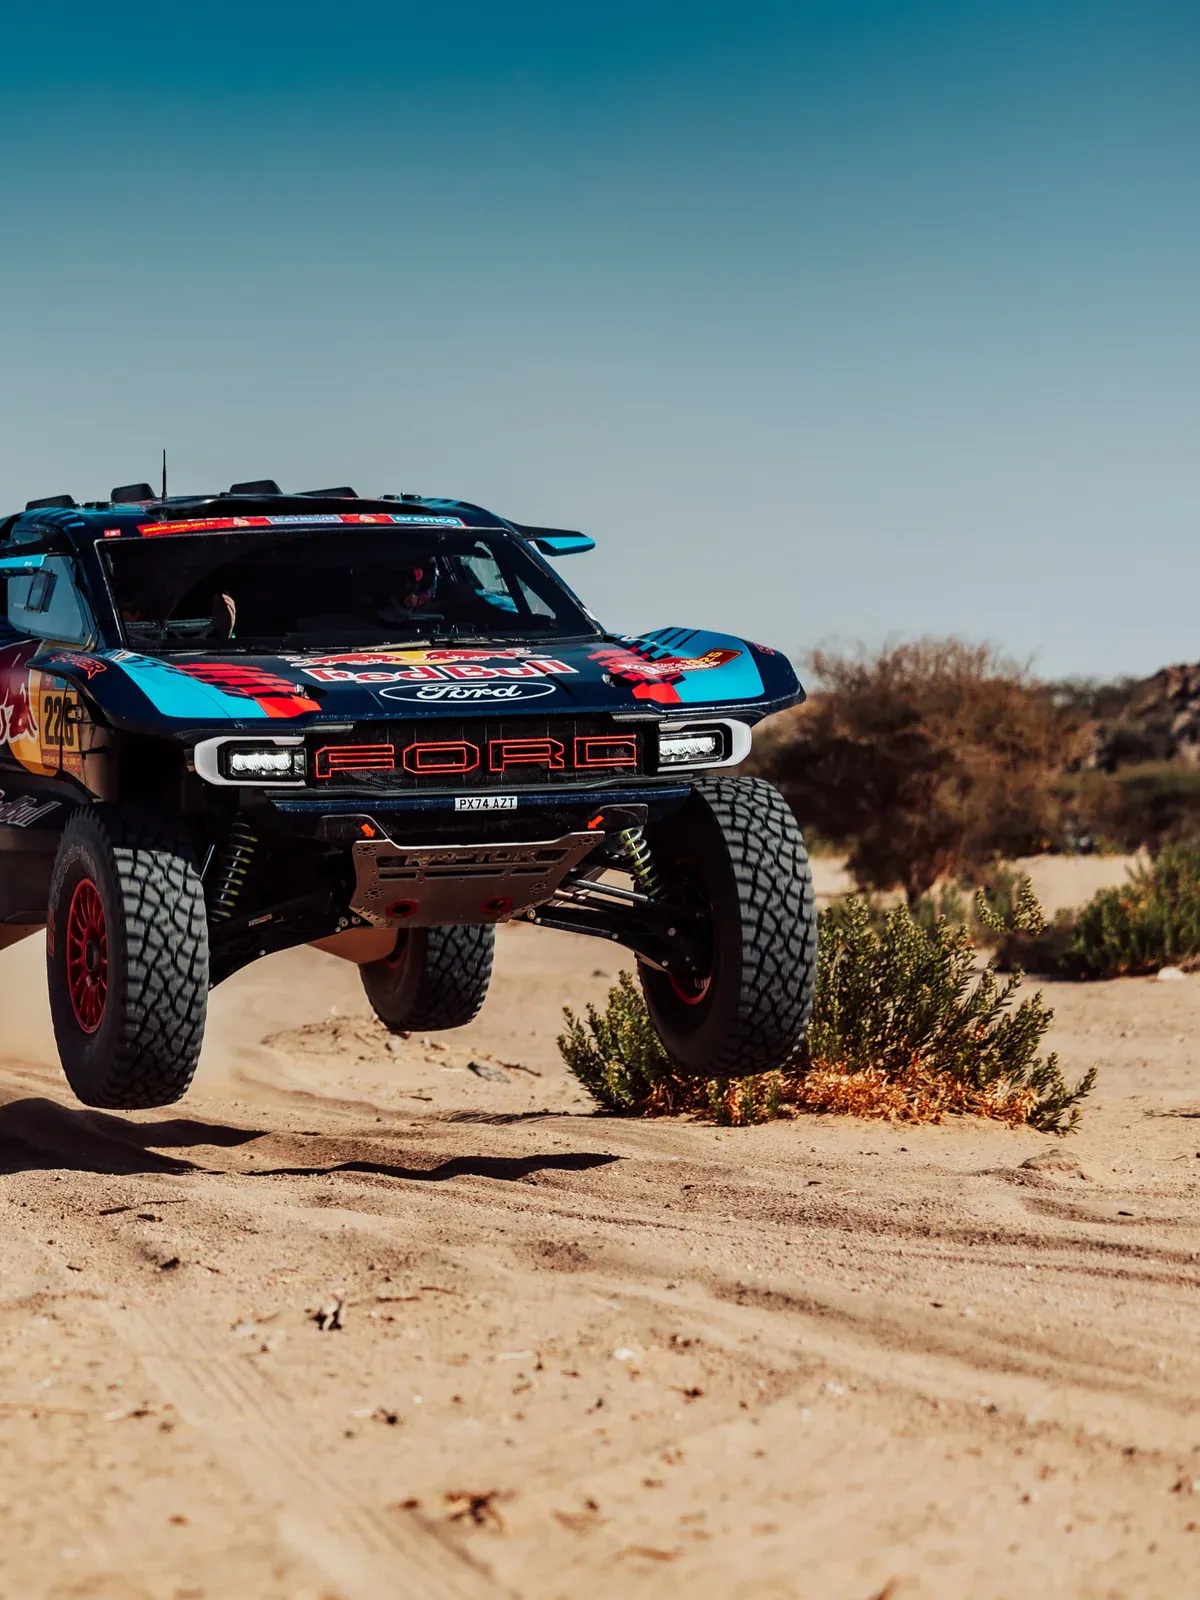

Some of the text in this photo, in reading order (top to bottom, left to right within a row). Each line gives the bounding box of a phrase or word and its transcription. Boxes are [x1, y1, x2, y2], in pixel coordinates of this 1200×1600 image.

[395, 515, 458, 525] aramco
[415, 682, 522, 699] Ford
[315, 735, 637, 778] FORD
[459, 797, 515, 810] PX74 AZT
